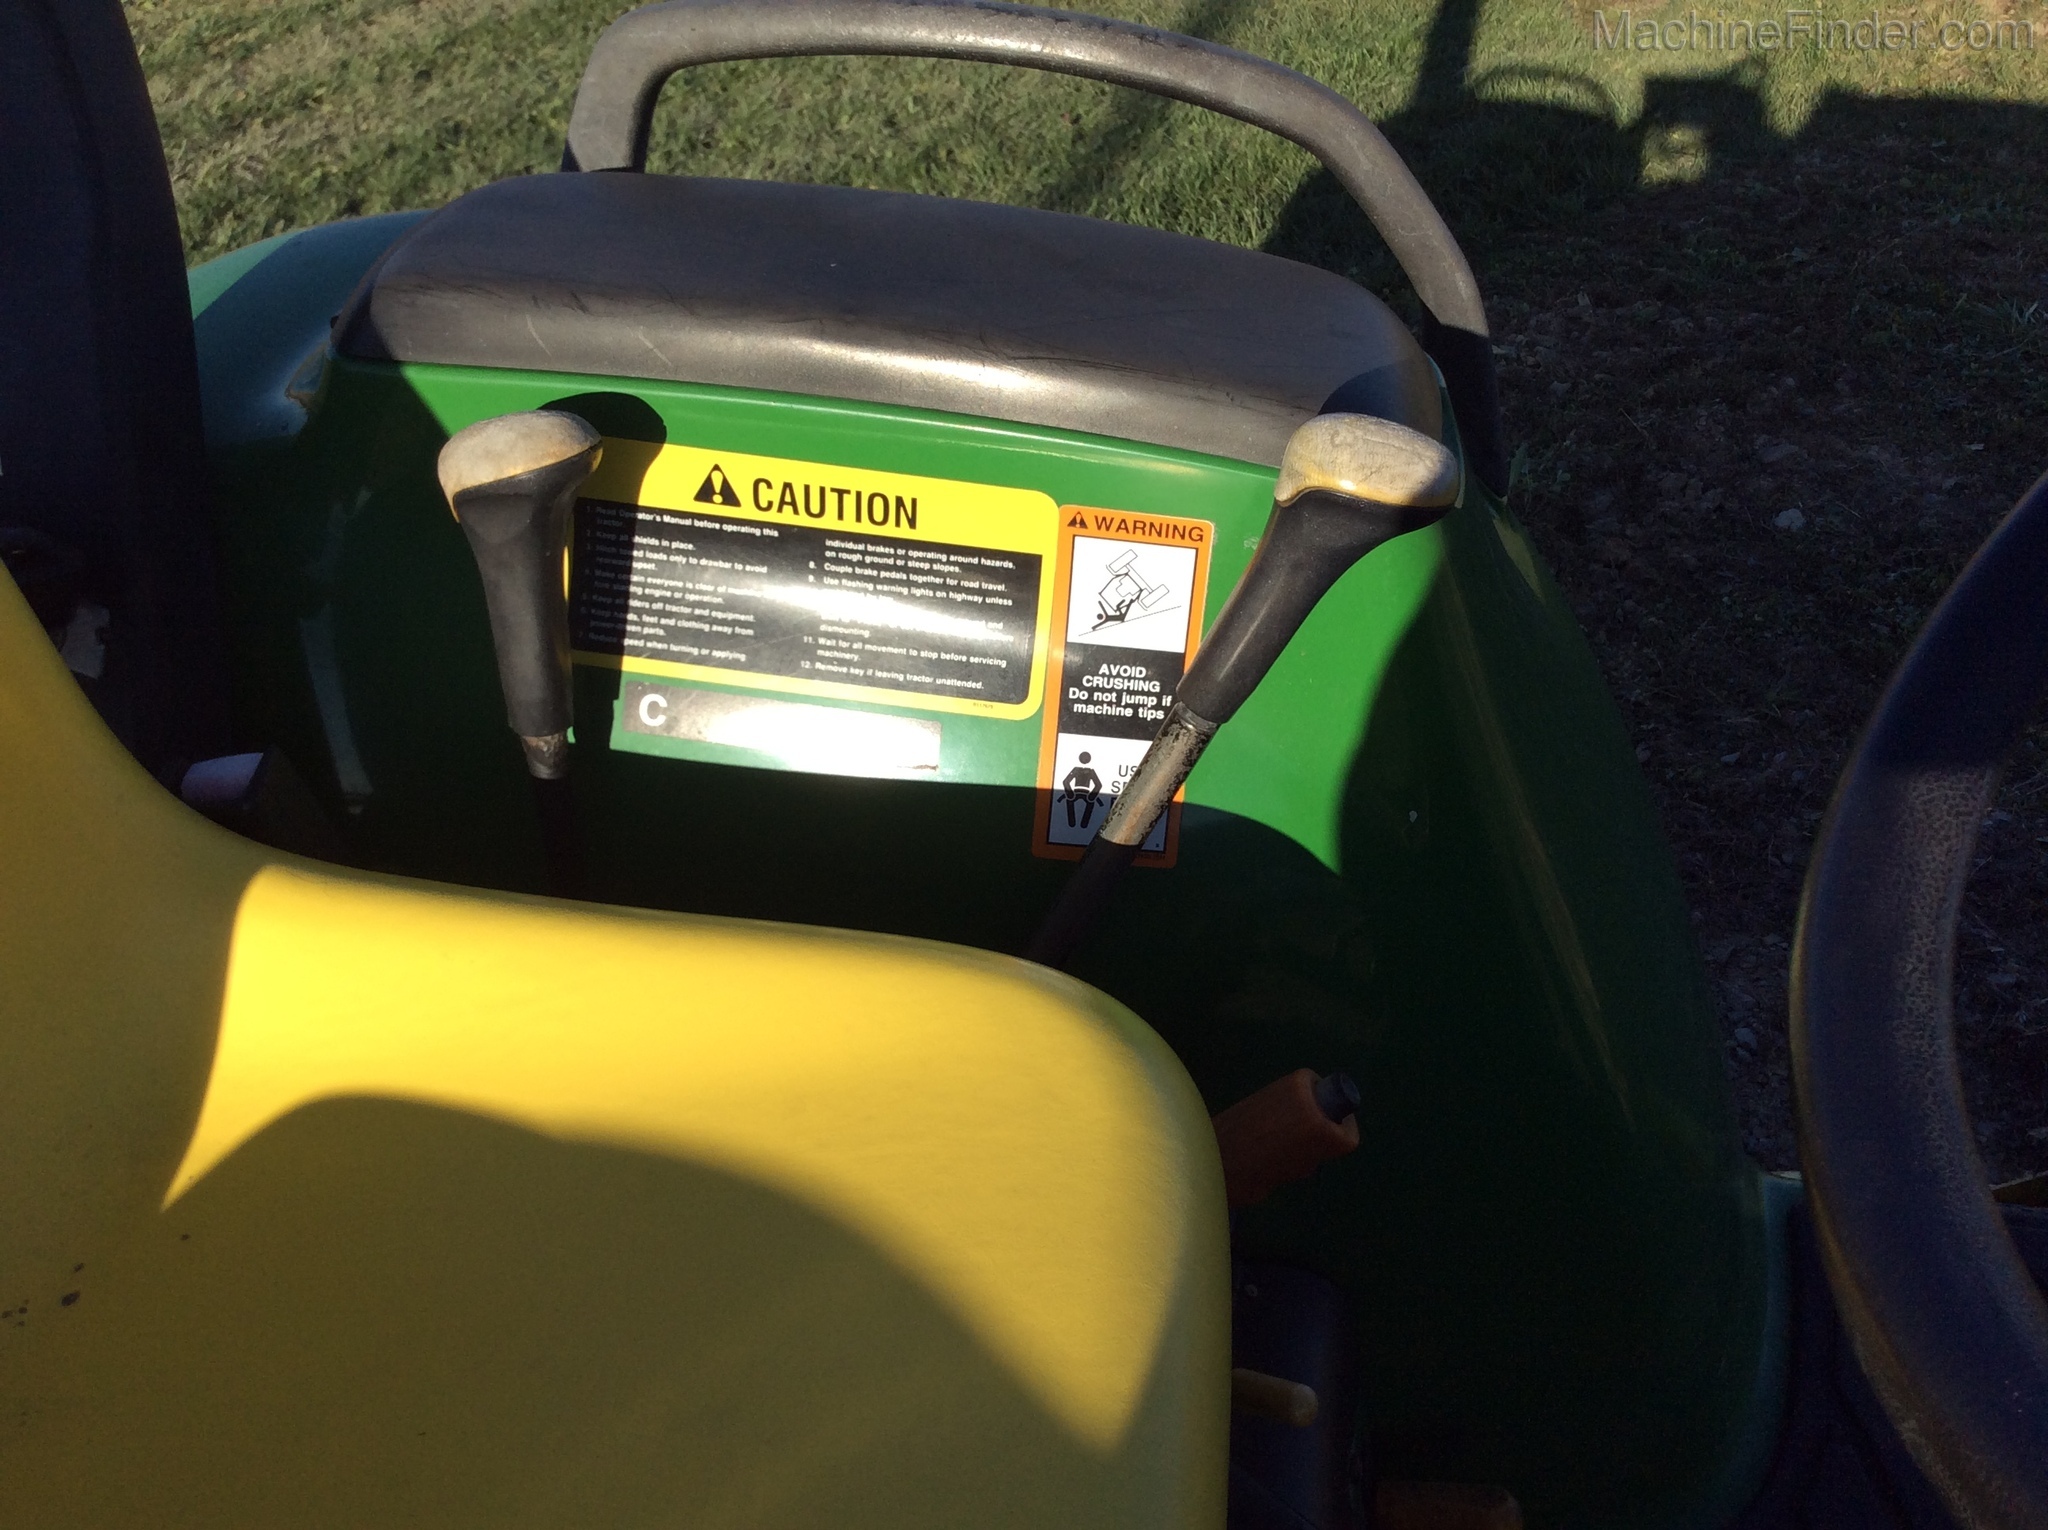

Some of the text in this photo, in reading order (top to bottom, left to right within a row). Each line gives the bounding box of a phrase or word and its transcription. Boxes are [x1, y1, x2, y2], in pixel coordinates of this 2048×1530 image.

[752, 477, 919, 531] CAUTION
[663, 515, 692, 526] Manual
[694, 519, 720, 530] before
[722, 523, 761, 536] operating
[763, 528, 779, 537] this
[1094, 515, 1204, 542] WARNING
[632, 535, 660, 546] shields
[661, 539, 670, 547] in
[671, 541, 696, 551] place.
[825, 539, 865, 550] individual
[867, 544, 894, 555] brakes
[897, 548, 906, 556] or
[908, 549, 947, 561] operating
[950, 555, 978, 565] around
[633, 561, 658, 571] upset.
[646, 550, 667, 561] loads
[669, 554, 687, 564] only
[689, 556, 698, 564] to
[699, 557, 732, 569] drawbar
[734, 562, 743, 571] to
[745, 564, 767, 573] avoid
[825, 550, 962, 573] on rough ground or steep slopes.
[647, 575, 683, 588] everyone
[685, 580, 693, 589] is
[695, 582, 715, 591] clear
[717, 584, 727, 592] of
[809, 561, 1007, 592] 8. Couple brake pedals together for road travel.
[644, 588, 671, 598] engine
[674, 591, 682, 599] or
[684, 592, 724, 604] operation.
[808, 575, 1013, 606] 9. Use flashing warning lights on highway unless
[652, 602, 664, 610] off
[665, 604, 692, 614] tractor
[694, 607, 709, 616] and
[711, 609, 756, 623] equipment.
[642, 614, 658, 624] feet
[660, 617, 676, 626] and
[677, 619, 709, 632] clothing
[711, 624, 732, 635] away
[735, 626, 754, 636] from
[643, 626, 666, 636] parts.
[621, 638, 644, 647] speed
[646, 640, 668, 650] when
[670, 644, 699, 655] turning
[711, 650, 746, 661] applying
[803, 636, 1006, 668] 11. Wait for all movement to stop before servicing
[817, 648, 861, 662] machinery.
[800, 660, 813, 669] 12.
[815, 662, 848, 673] Remove
[850, 666, 864, 676] key
[875, 669, 904, 681] leaving
[906, 673, 934, 683] tractor
[936, 676, 984, 689] unattended.
[1099, 664, 1146, 678] AVOID
[1082, 675, 1160, 692] CRUSHING
[1069, 687, 1172, 706] Do not jump if
[638, 693, 668, 728] C
[1074, 702, 1164, 720] machine tips
[1118, 764, 1138, 778] US
